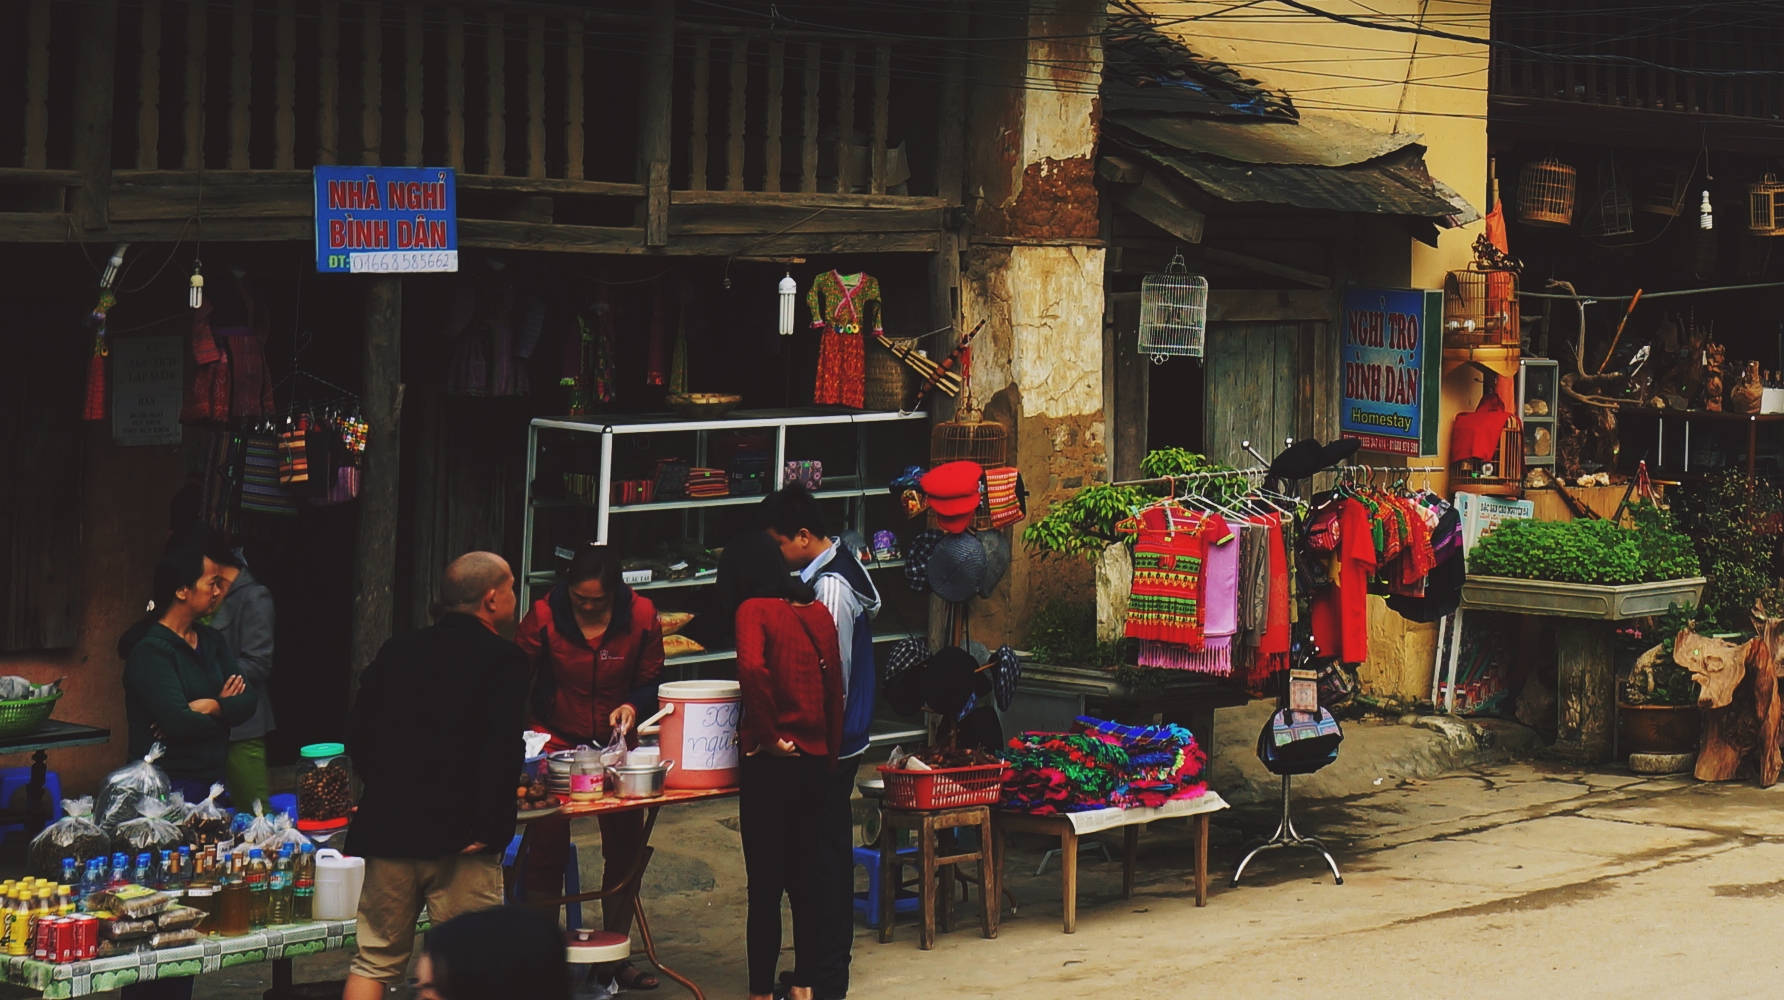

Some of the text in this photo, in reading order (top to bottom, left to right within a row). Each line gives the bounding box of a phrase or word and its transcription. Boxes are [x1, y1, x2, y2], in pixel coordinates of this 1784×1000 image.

[328, 171, 446, 211] NHÀ NGHỈ
[329, 213, 447, 249] BÌNH DÂN
[328, 254, 350, 268] ĐT:
[1346, 295, 1419, 361] NGHỈ TRỌ
[1345, 351, 1419, 406] BÌNH DÂN
[1352, 406, 1413, 432] Homestay
